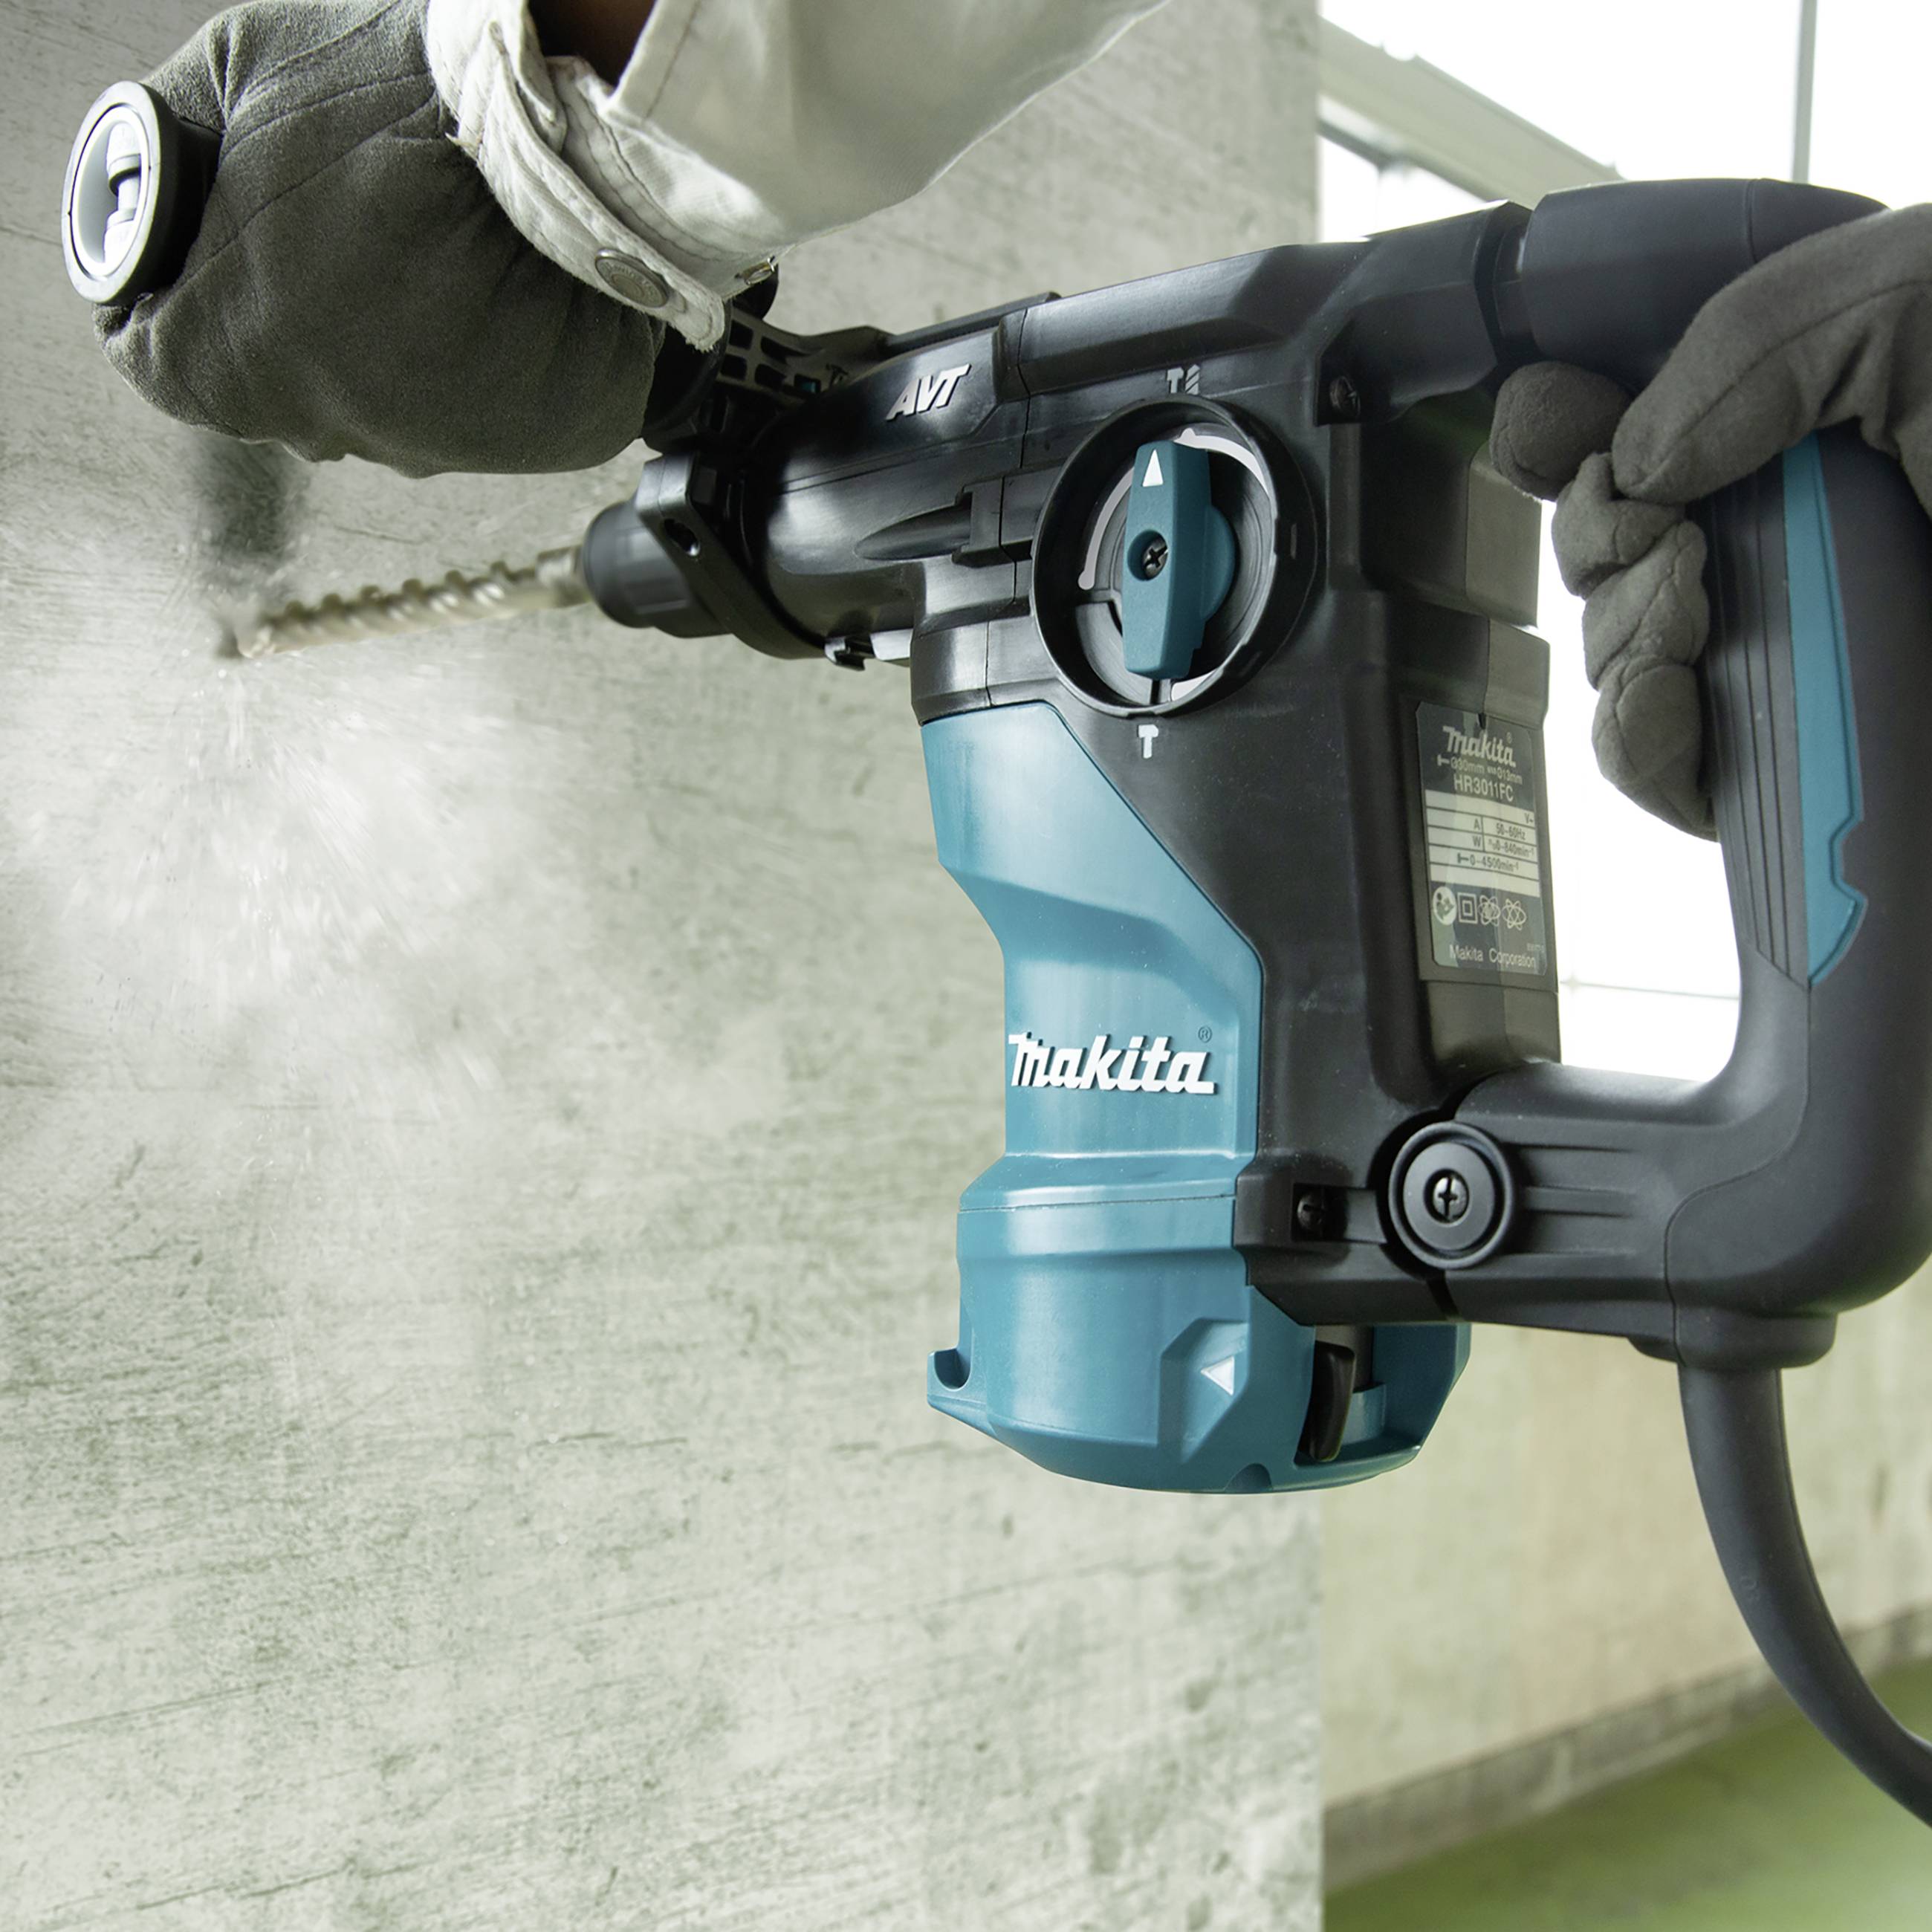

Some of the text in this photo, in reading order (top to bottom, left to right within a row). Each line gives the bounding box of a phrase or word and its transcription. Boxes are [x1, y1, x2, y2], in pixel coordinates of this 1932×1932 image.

[885, 363, 970, 421] AVT
[1453, 774, 1514, 802] HR3011FC
[1474, 818, 1481, 831] A
[1472, 835, 1481, 847] W
[1450, 944, 1484, 962] Makita
[1488, 947, 1535, 968] Corporation
